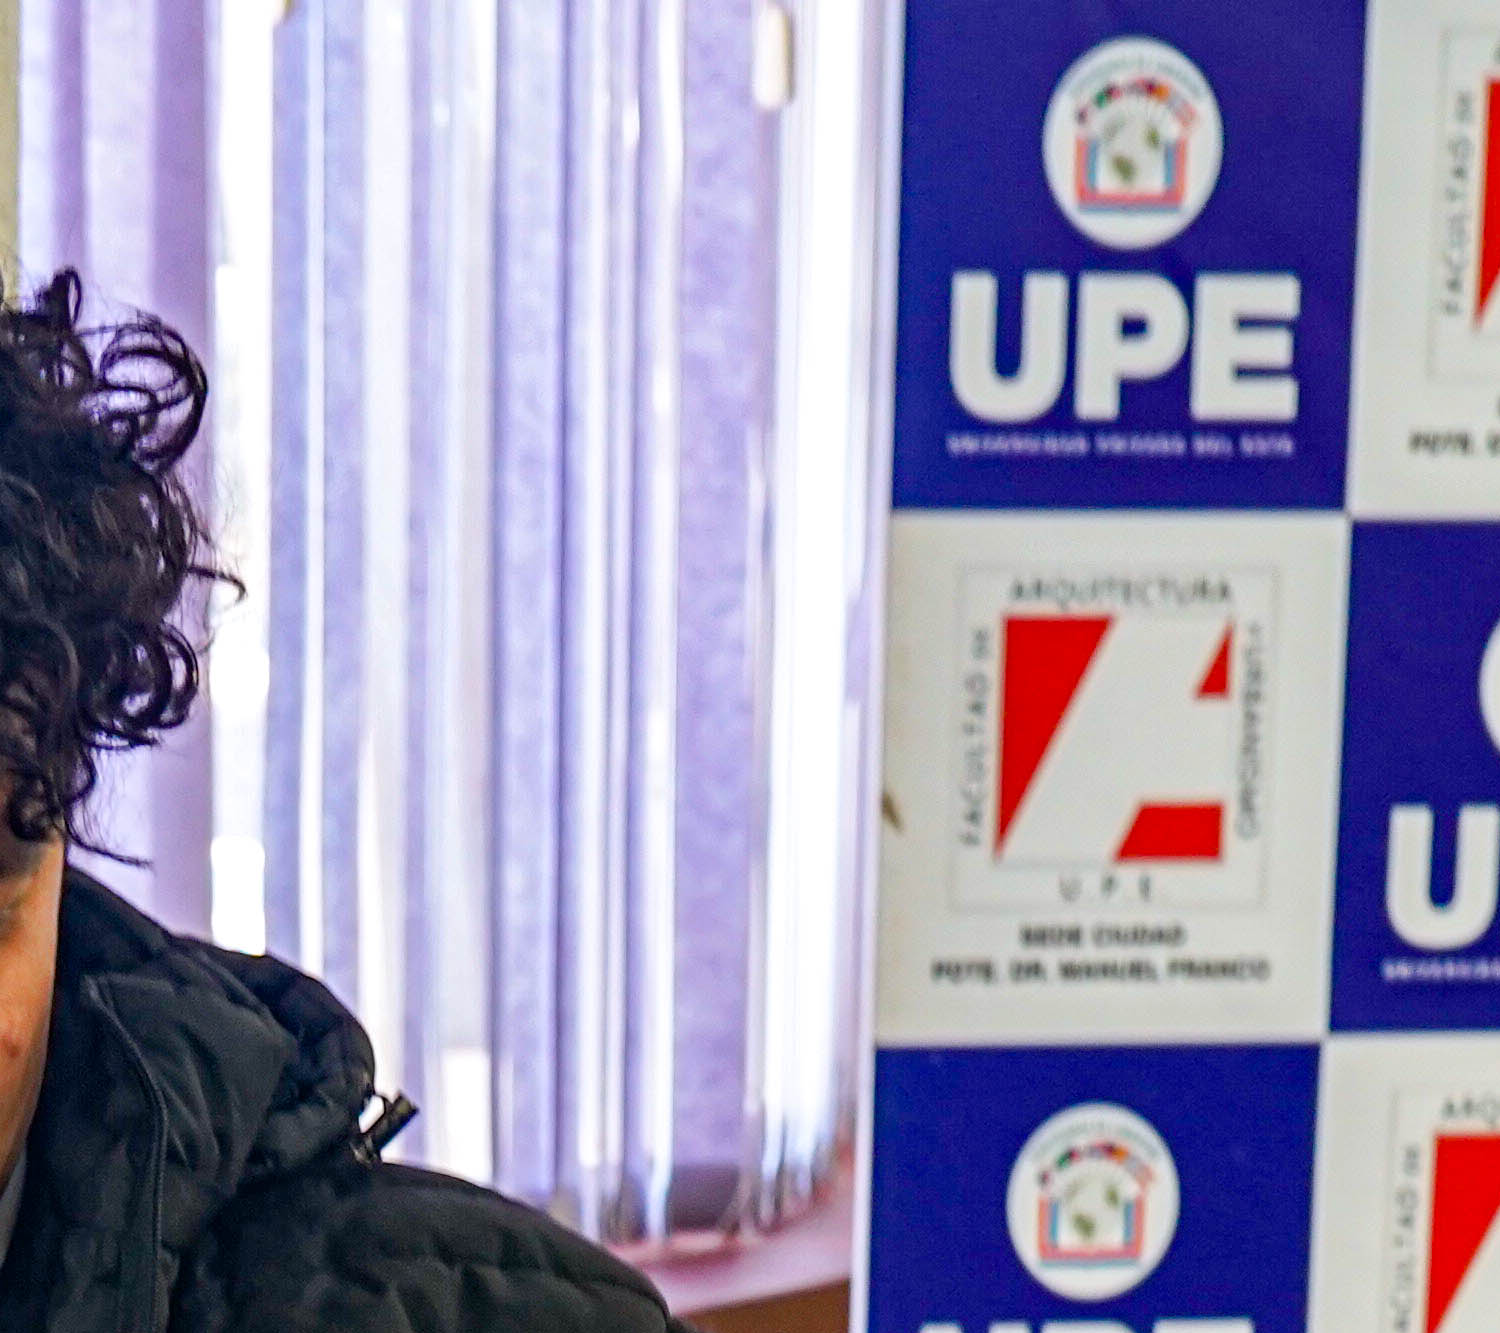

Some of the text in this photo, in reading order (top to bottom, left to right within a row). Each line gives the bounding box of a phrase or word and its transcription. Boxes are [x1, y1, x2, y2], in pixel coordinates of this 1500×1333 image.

[948, 270, 1302, 423] UPE
[1008, 577, 1232, 607] ARQUITECTURA
[1166, 956, 1271, 982] FRANCO
